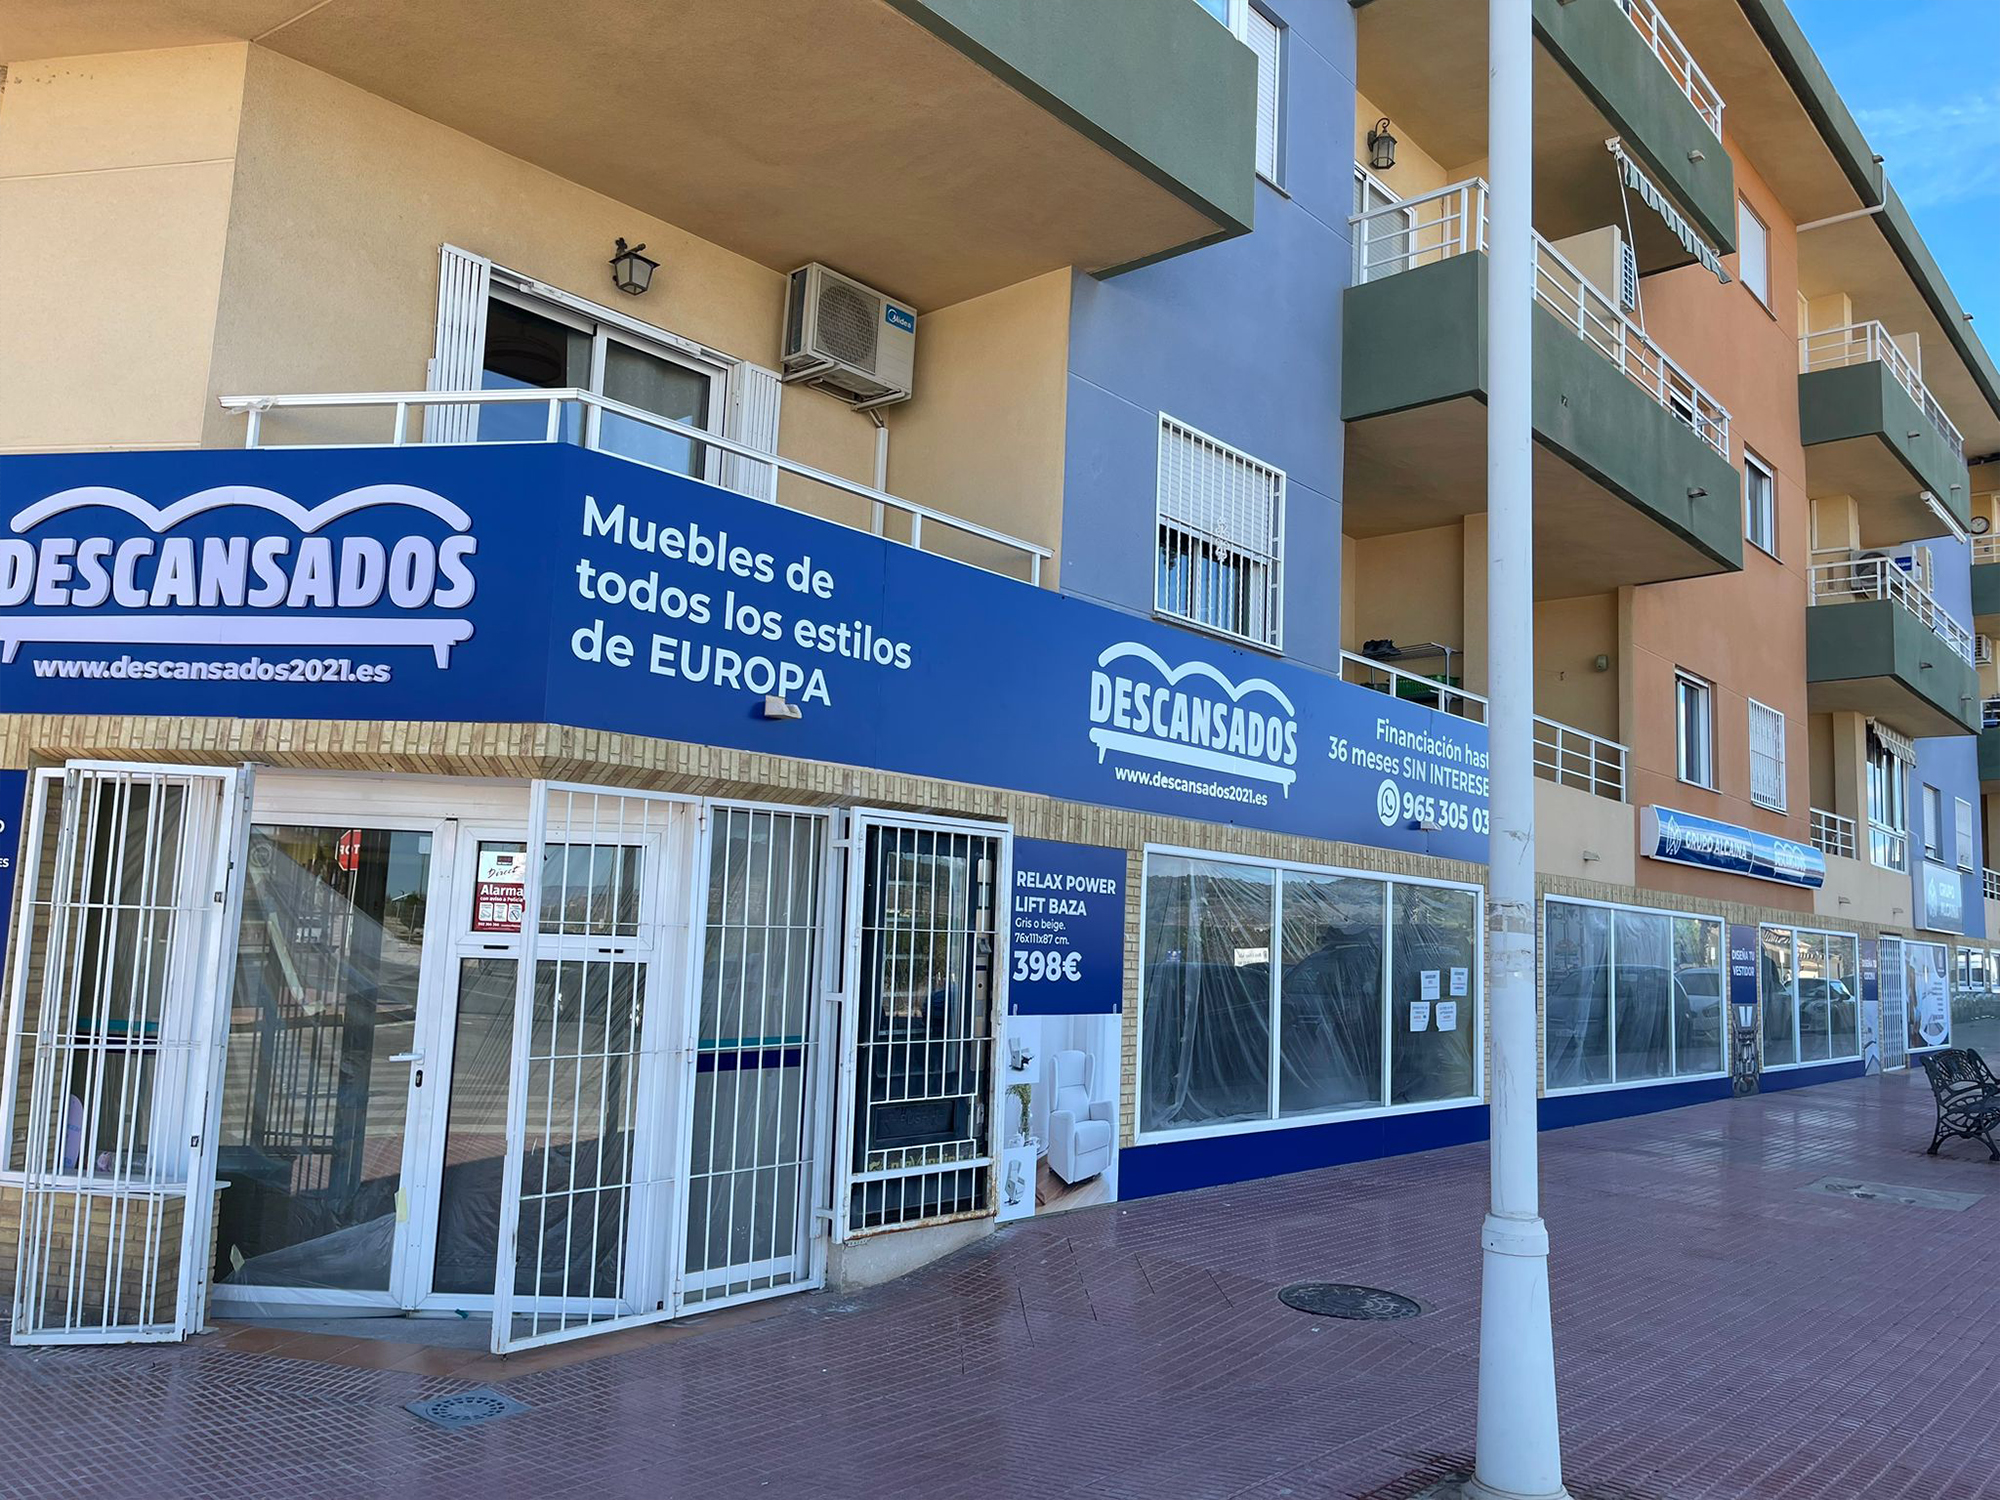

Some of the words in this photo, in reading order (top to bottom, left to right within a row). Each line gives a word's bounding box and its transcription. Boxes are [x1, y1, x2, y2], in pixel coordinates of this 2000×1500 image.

[582, 495, 775, 584] Muebles
[785, 556, 835, 599] de
[0, 535, 477, 609] DESCANSADOS
[575, 558, 711, 624] todos
[724, 590, 783, 641] los
[794, 620, 912, 670] estilos
[33, 655, 391, 683] www.descansados2021.es
[571, 619, 634, 668] de
[649, 633, 832, 707] EUROPA
[1089, 670, 1298, 766] DESCANSADOS
[1376, 718, 1462, 763] Financiación
[1465, 743, 1489, 770] hast
[1328, 735, 1348, 762] 36
[1351, 746, 1400, 776] meses
[1402, 756, 1427, 783] SIN
[1430, 763, 1489, 798] INTERESE
[1114, 766, 1268, 806] www.descansados2021.es
[1402, 791, 1435, 823] 965
[1438, 799, 1469, 831] 305
[1472, 807, 1489, 835] 03
[1685, 831, 1713, 852] GRUPO
[480, 884, 524, 897] Alarma
[1016, 870, 1063, 890] RELAX
[1066, 876, 1116, 895] POWER
[1015, 895, 1046, 913] LIFT
[1049, 898, 1087, 916] BAZA
[1014, 932, 1053, 945] 76x111x87
[1054, 935, 1070, 945] cm.
[1015, 917, 1032, 929] Gris
[1033, 920, 1039, 929] o
[1041, 919, 1066, 932] beige.
[1012, 950, 1082, 982] 398€
[1732, 965, 1755, 977] VESTIDOR
